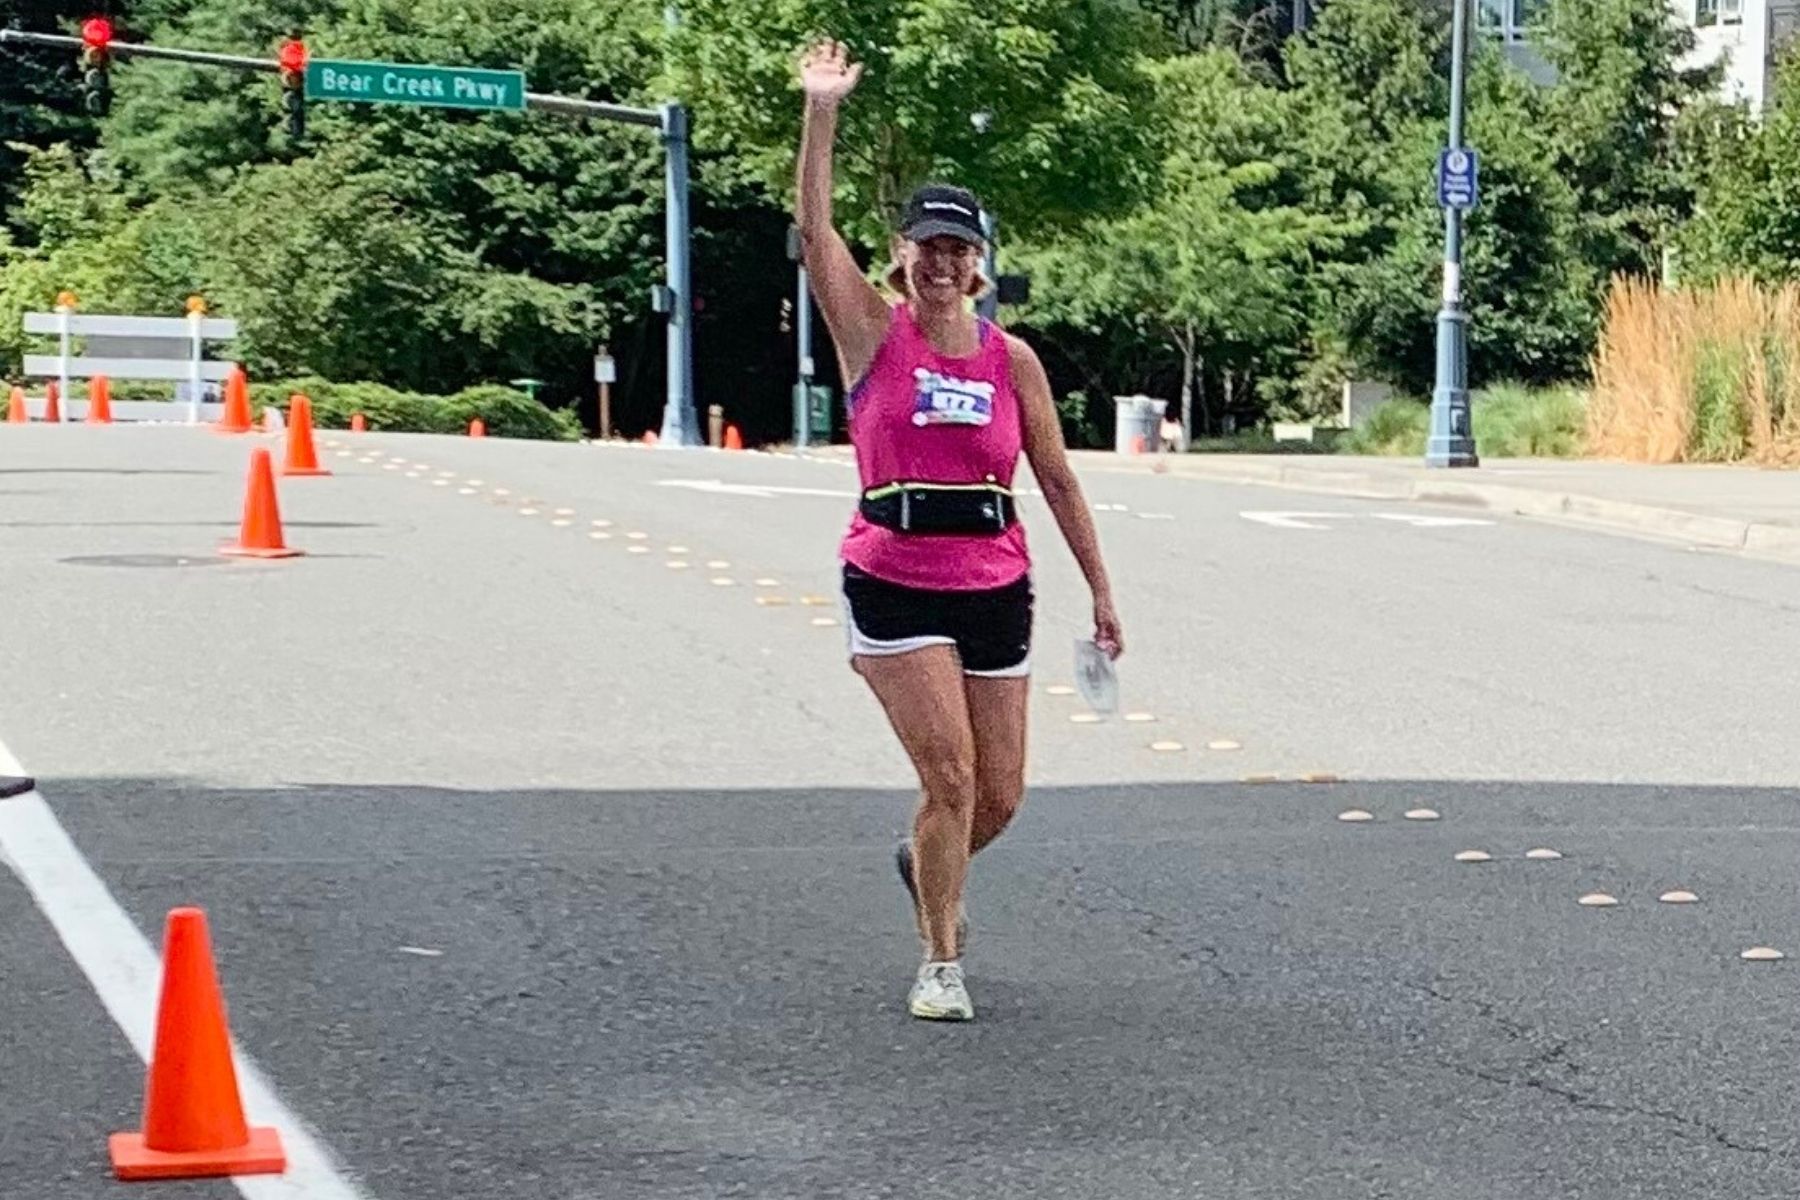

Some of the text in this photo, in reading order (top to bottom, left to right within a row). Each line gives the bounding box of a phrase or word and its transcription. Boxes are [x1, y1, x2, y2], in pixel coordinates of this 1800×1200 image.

[321, 67, 507, 105] Bear Creek Pkwy
